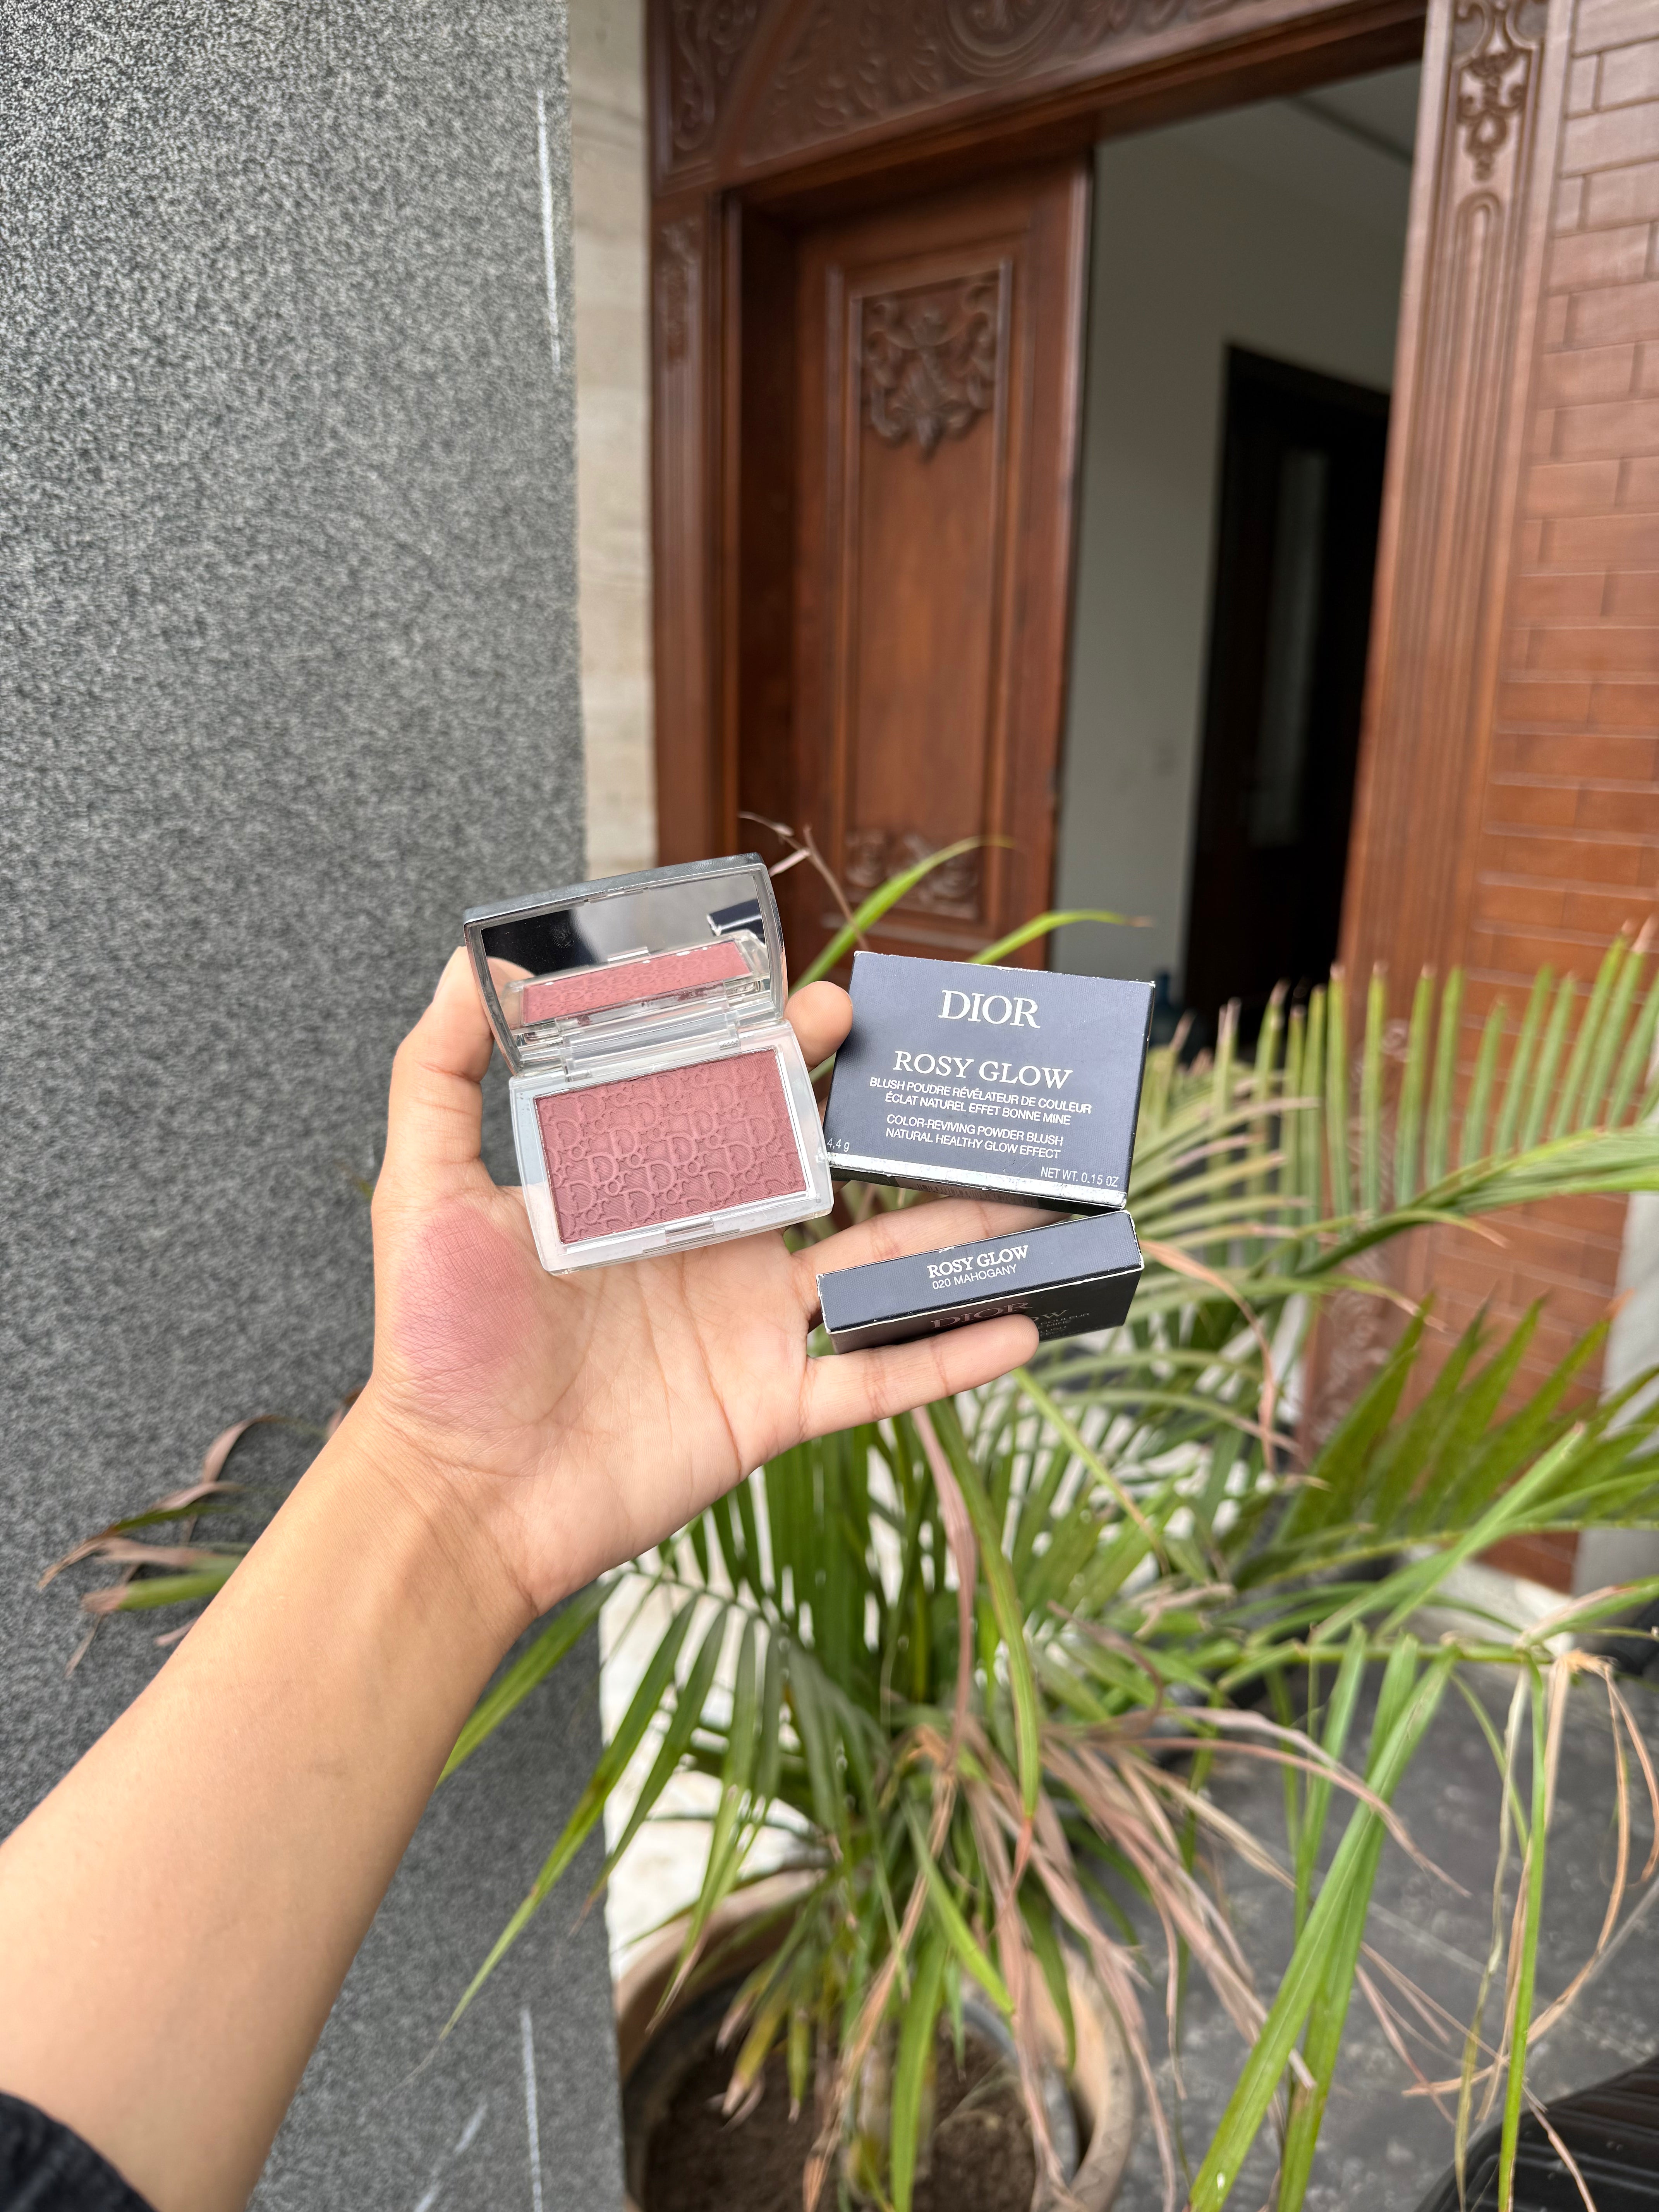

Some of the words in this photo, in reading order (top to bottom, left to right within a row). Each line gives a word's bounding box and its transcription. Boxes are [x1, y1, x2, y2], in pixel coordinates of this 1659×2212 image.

[938, 989, 1041, 1029] DIOR
[893, 1051, 975, 1078] ROSY
[979, 1061, 1073, 1089] GLOW
[869, 1077, 905, 1090] BLUSH
[906, 1082, 951, 1096] POUDRE
[952, 1086, 1019, 1104] RÉVÉLATEUR
[1020, 1096, 1037, 1107] DE
[1038, 1098, 1092, 1114] COULEUR
[885, 1091, 919, 1105] ÉCLAT
[919, 1097, 967, 1112] NATUREL
[969, 1103, 1001, 1116] EFFET
[1002, 1107, 1041, 1121] BONNE
[1042, 1113, 1072, 1125] MINE
[827, 1137, 841, 1149] 4,4
[843, 1142, 850, 1152] g
[886, 1127, 933, 1143] NATURAL
[935, 1134, 983, 1149] HEALTHY
[984, 1140, 1018, 1154] GLOW
[1019, 1145, 1061, 1159] EFFECT
[887, 1114, 975, 1134] COLOR-REVIVING
[977, 1125, 1025, 1141] POWDER
[1026, 1132, 1064, 1146] BLUSH
[1040, 1166, 1061, 1179] NET
[1062, 1169, 1078, 1182] WT.
[1081, 1172, 1103, 1185] 0.15
[1106, 1175, 1120, 1188] OZ
[927, 1256, 974, 1278] ROSY
[977, 1245, 1029, 1267] GLOW
[932, 1278, 951, 1290] 020
[953, 1264, 1017, 1285] MAHOGANY
[930, 1302, 1033, 1329] DIOR
